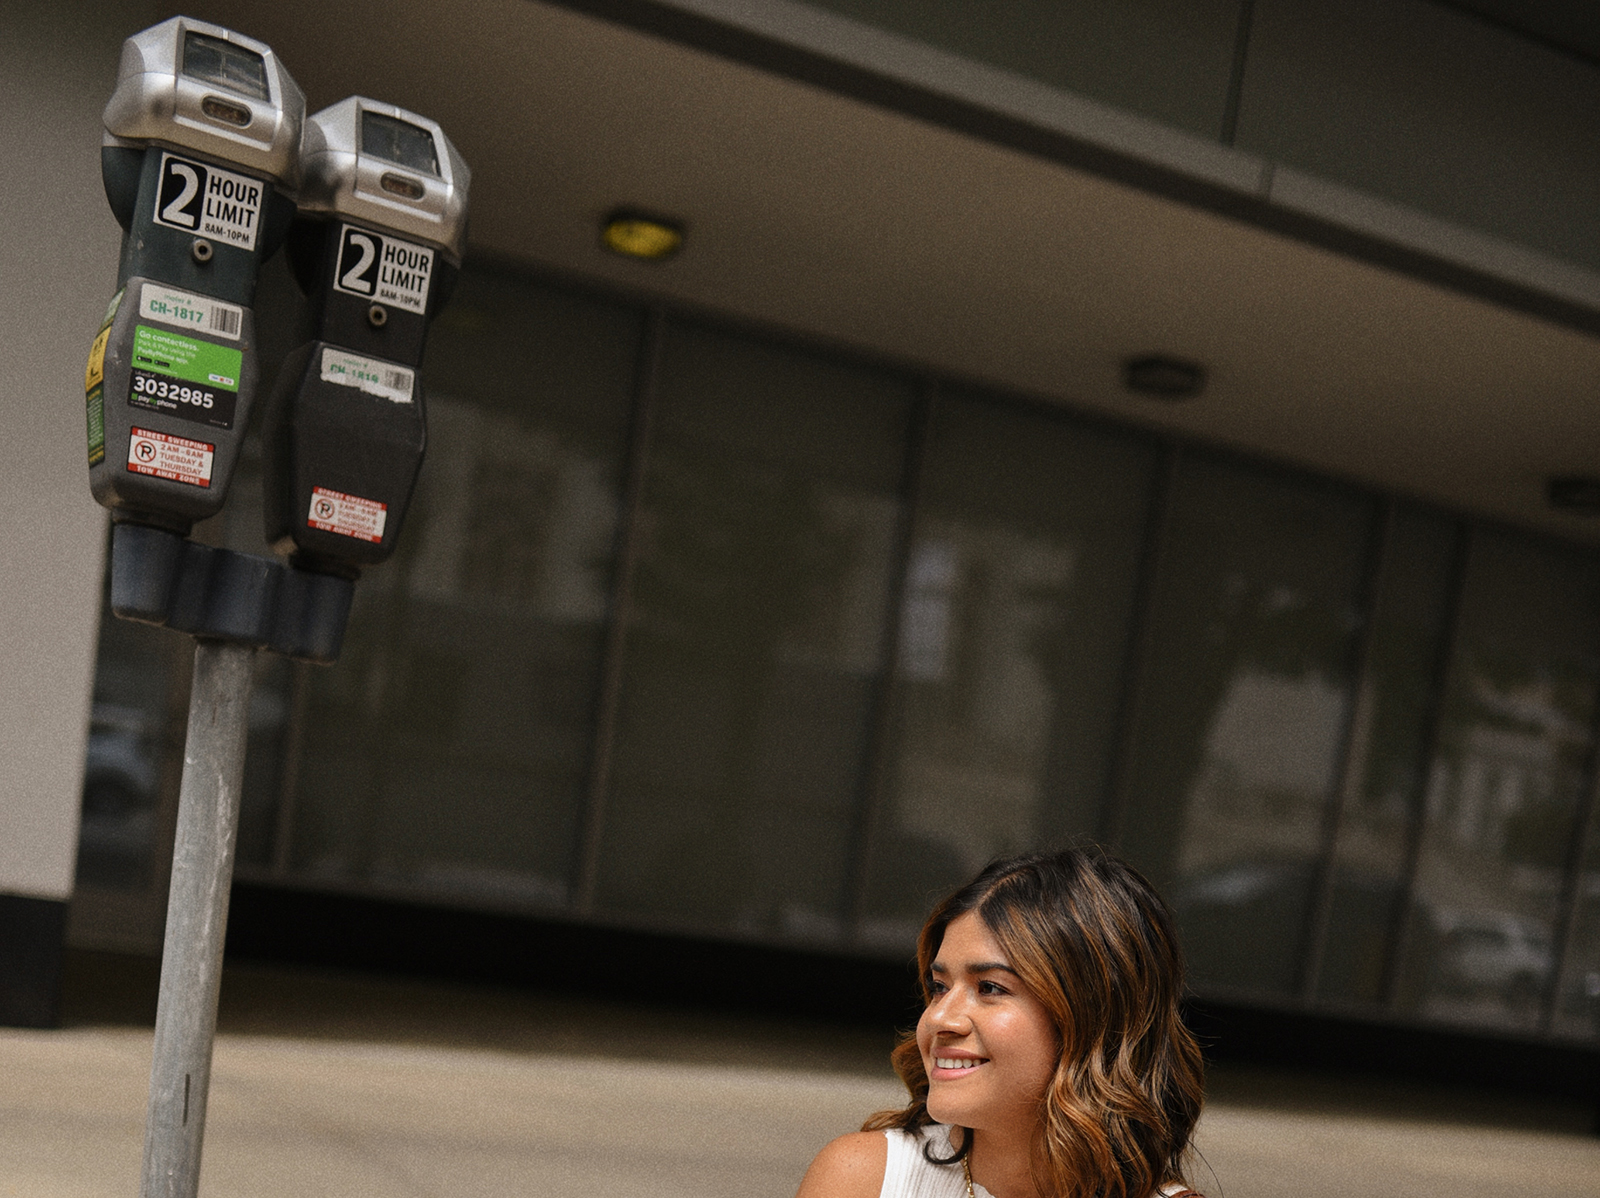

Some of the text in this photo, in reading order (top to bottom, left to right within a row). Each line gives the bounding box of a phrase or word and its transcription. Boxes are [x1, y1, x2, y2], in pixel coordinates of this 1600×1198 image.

[163, 163, 199, 227] 2
[209, 175, 259, 207] HOUR
[206, 198, 255, 228] LIMIT
[205, 223, 250, 243] 8AM-10PM
[342, 234, 376, 293] 2
[385, 244, 429, 273] HOUR
[382, 265, 425, 293] LIMIT
[150, 299, 204, 323] CH-1817
[139, 330, 151, 340] Go
[133, 375, 215, 410] 3032985
[137, 430, 208, 451] STREET SWEEPING
[160, 452, 197, 466] TUESDAY
[160, 461, 202, 476] THURSDAY
[137, 465, 154, 475] TOW
[156, 469, 177, 480] AWAY
